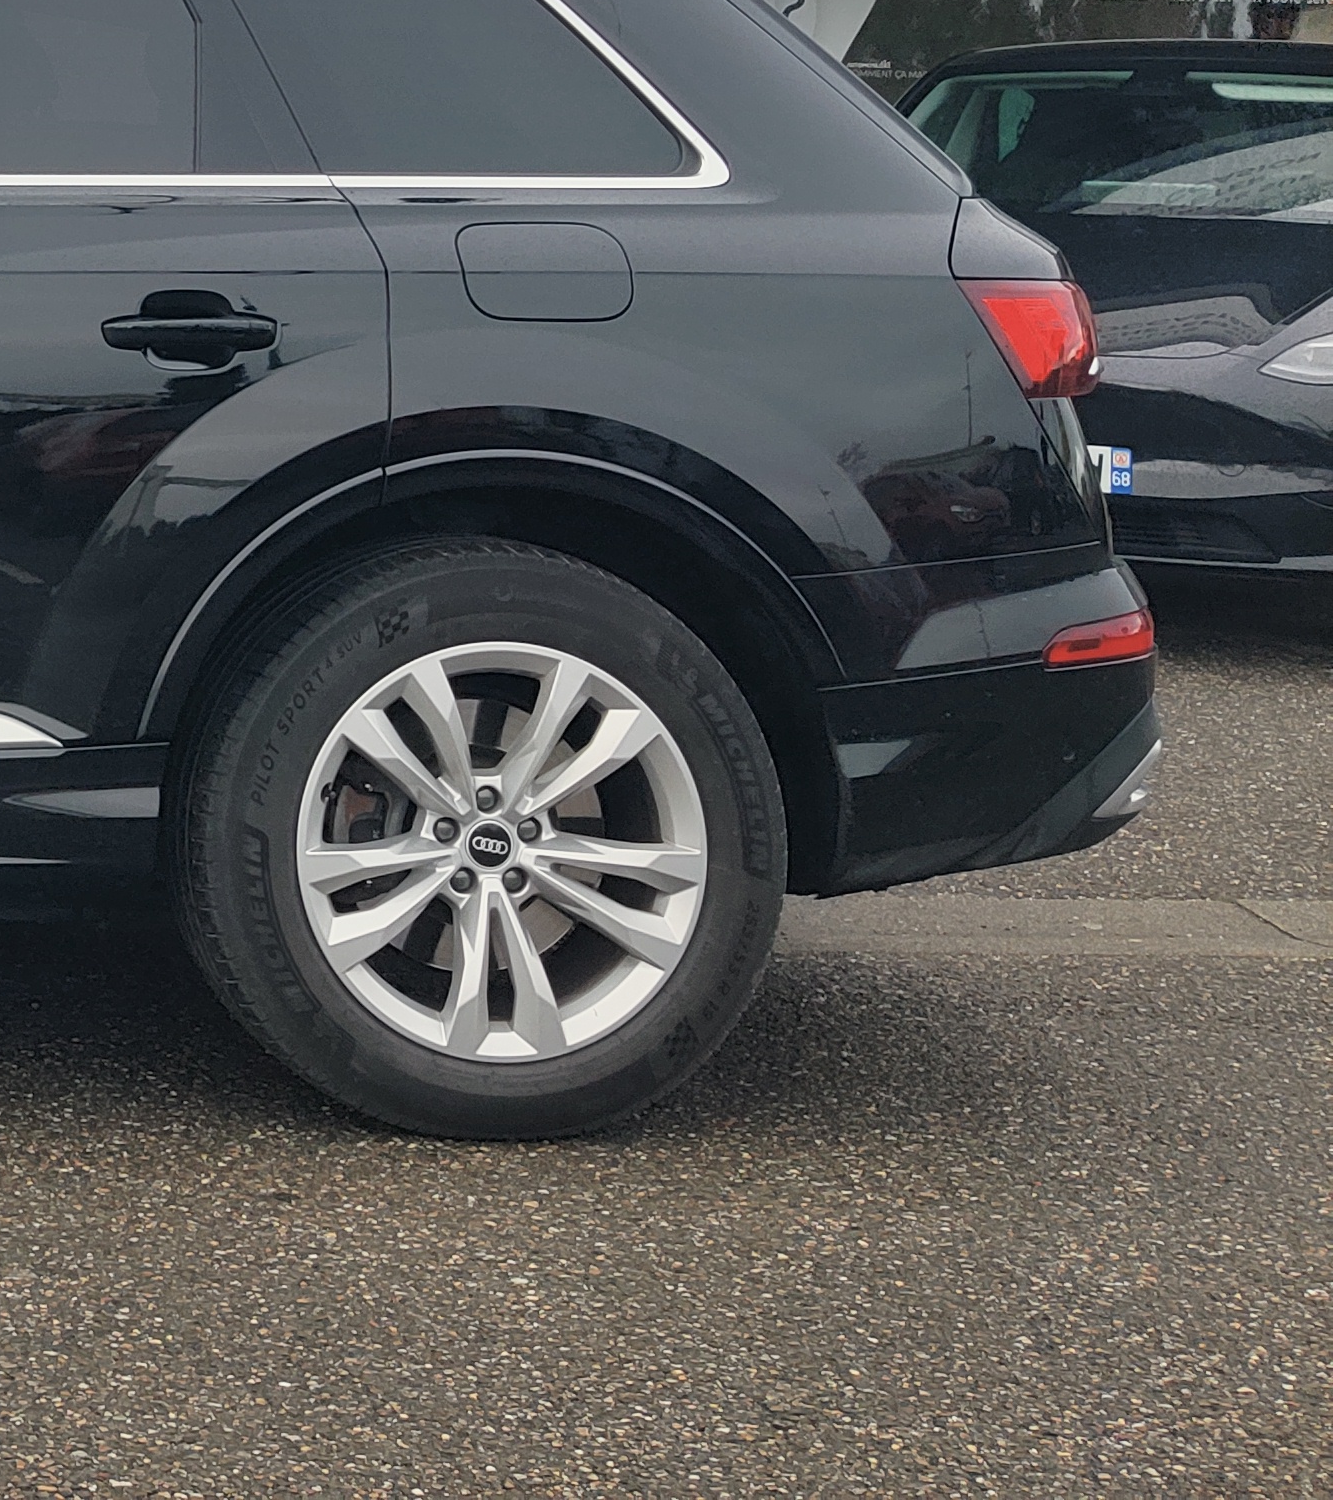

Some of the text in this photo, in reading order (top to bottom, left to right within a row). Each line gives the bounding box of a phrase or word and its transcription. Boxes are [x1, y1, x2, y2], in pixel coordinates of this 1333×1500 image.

[1112, 470, 1131, 488] 68
[250, 739, 281, 807] PILOT
[276, 667, 326, 736] SPORT
[337, 630, 363, 660] SUV
